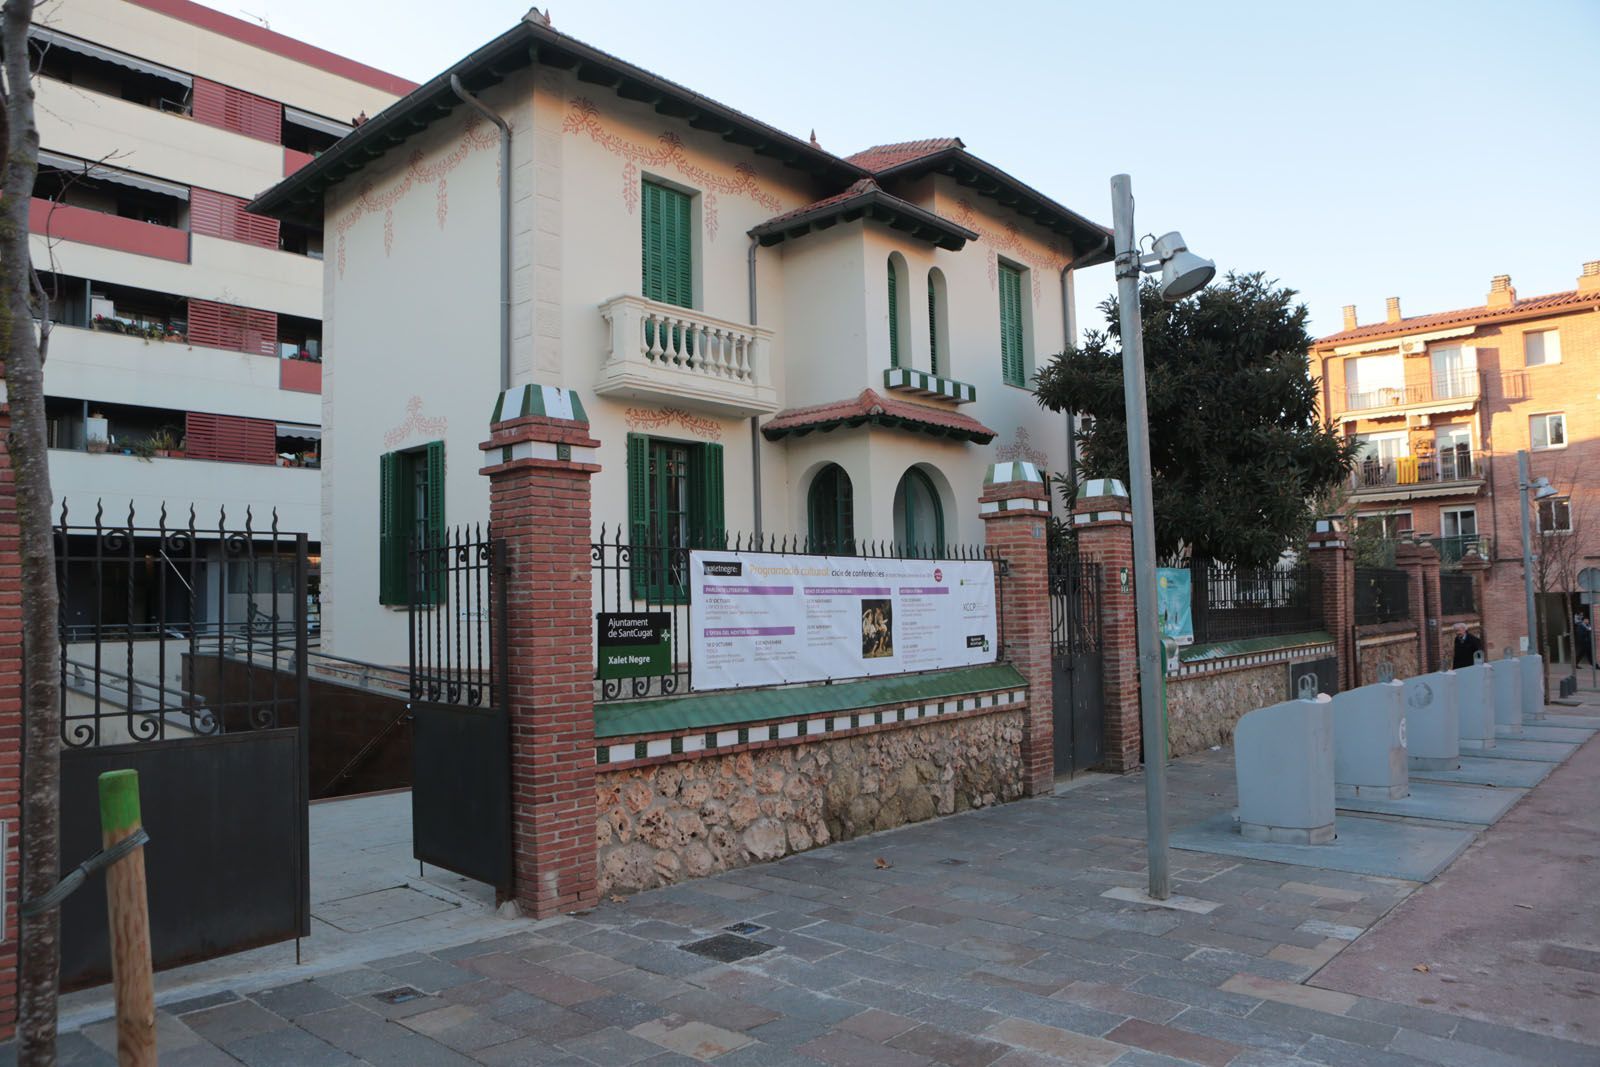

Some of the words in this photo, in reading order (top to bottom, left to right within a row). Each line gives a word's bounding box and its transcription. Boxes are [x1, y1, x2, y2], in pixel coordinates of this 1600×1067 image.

[608, 618, 648, 628] Ajuntament
[608, 629, 618, 638] de
[618, 629, 653, 639] SantCugat
[608, 656, 627, 665] Xalet
[629, 655, 651, 666] Negre
